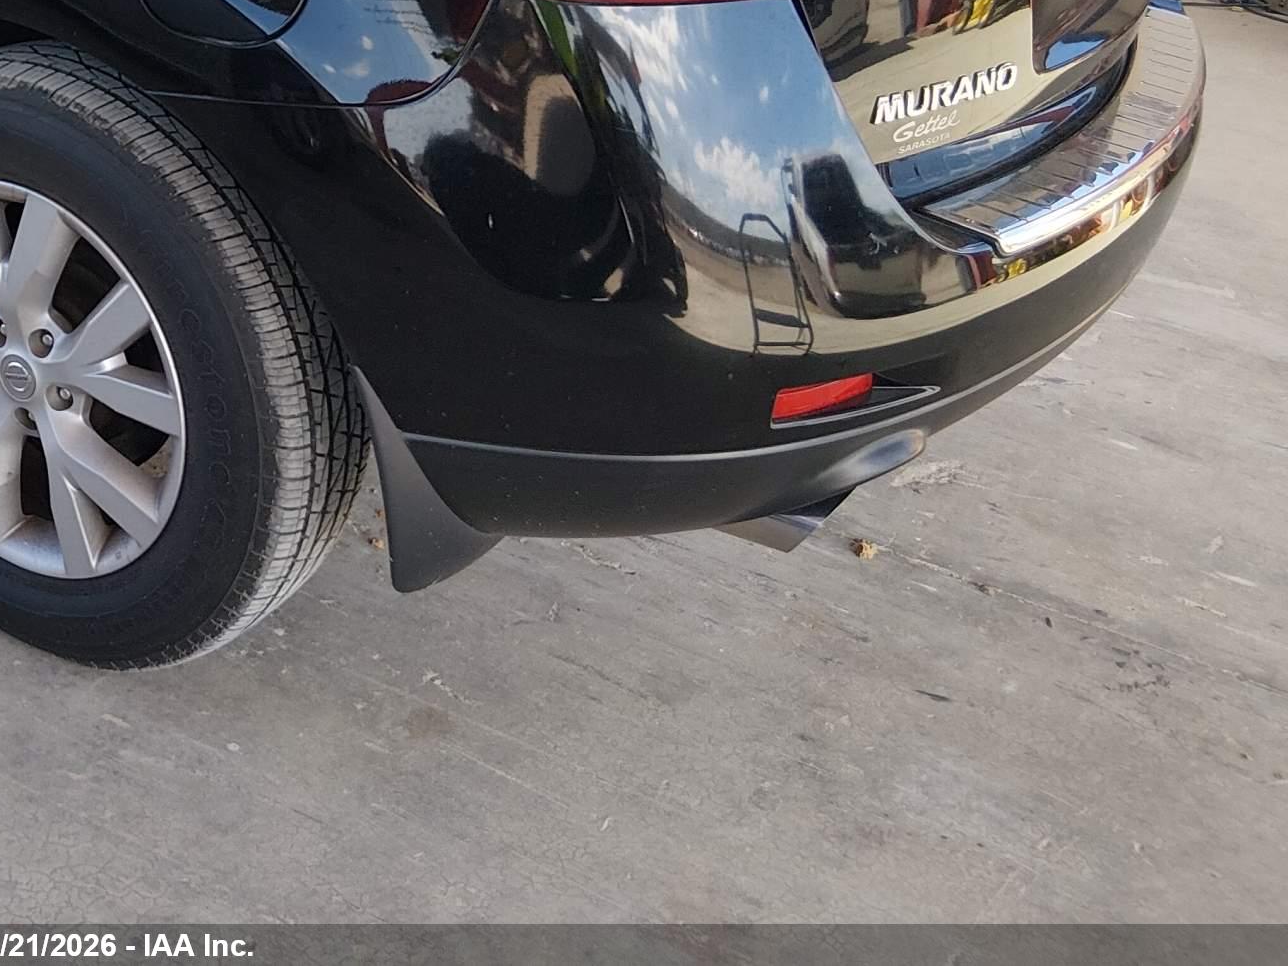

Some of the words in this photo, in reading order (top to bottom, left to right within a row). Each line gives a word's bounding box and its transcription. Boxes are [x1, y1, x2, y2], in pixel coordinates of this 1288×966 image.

[870, 61, 1018, 125] MURANO
[892, 109, 961, 143] Gettel
[898, 132, 952, 155] SARASOTA
